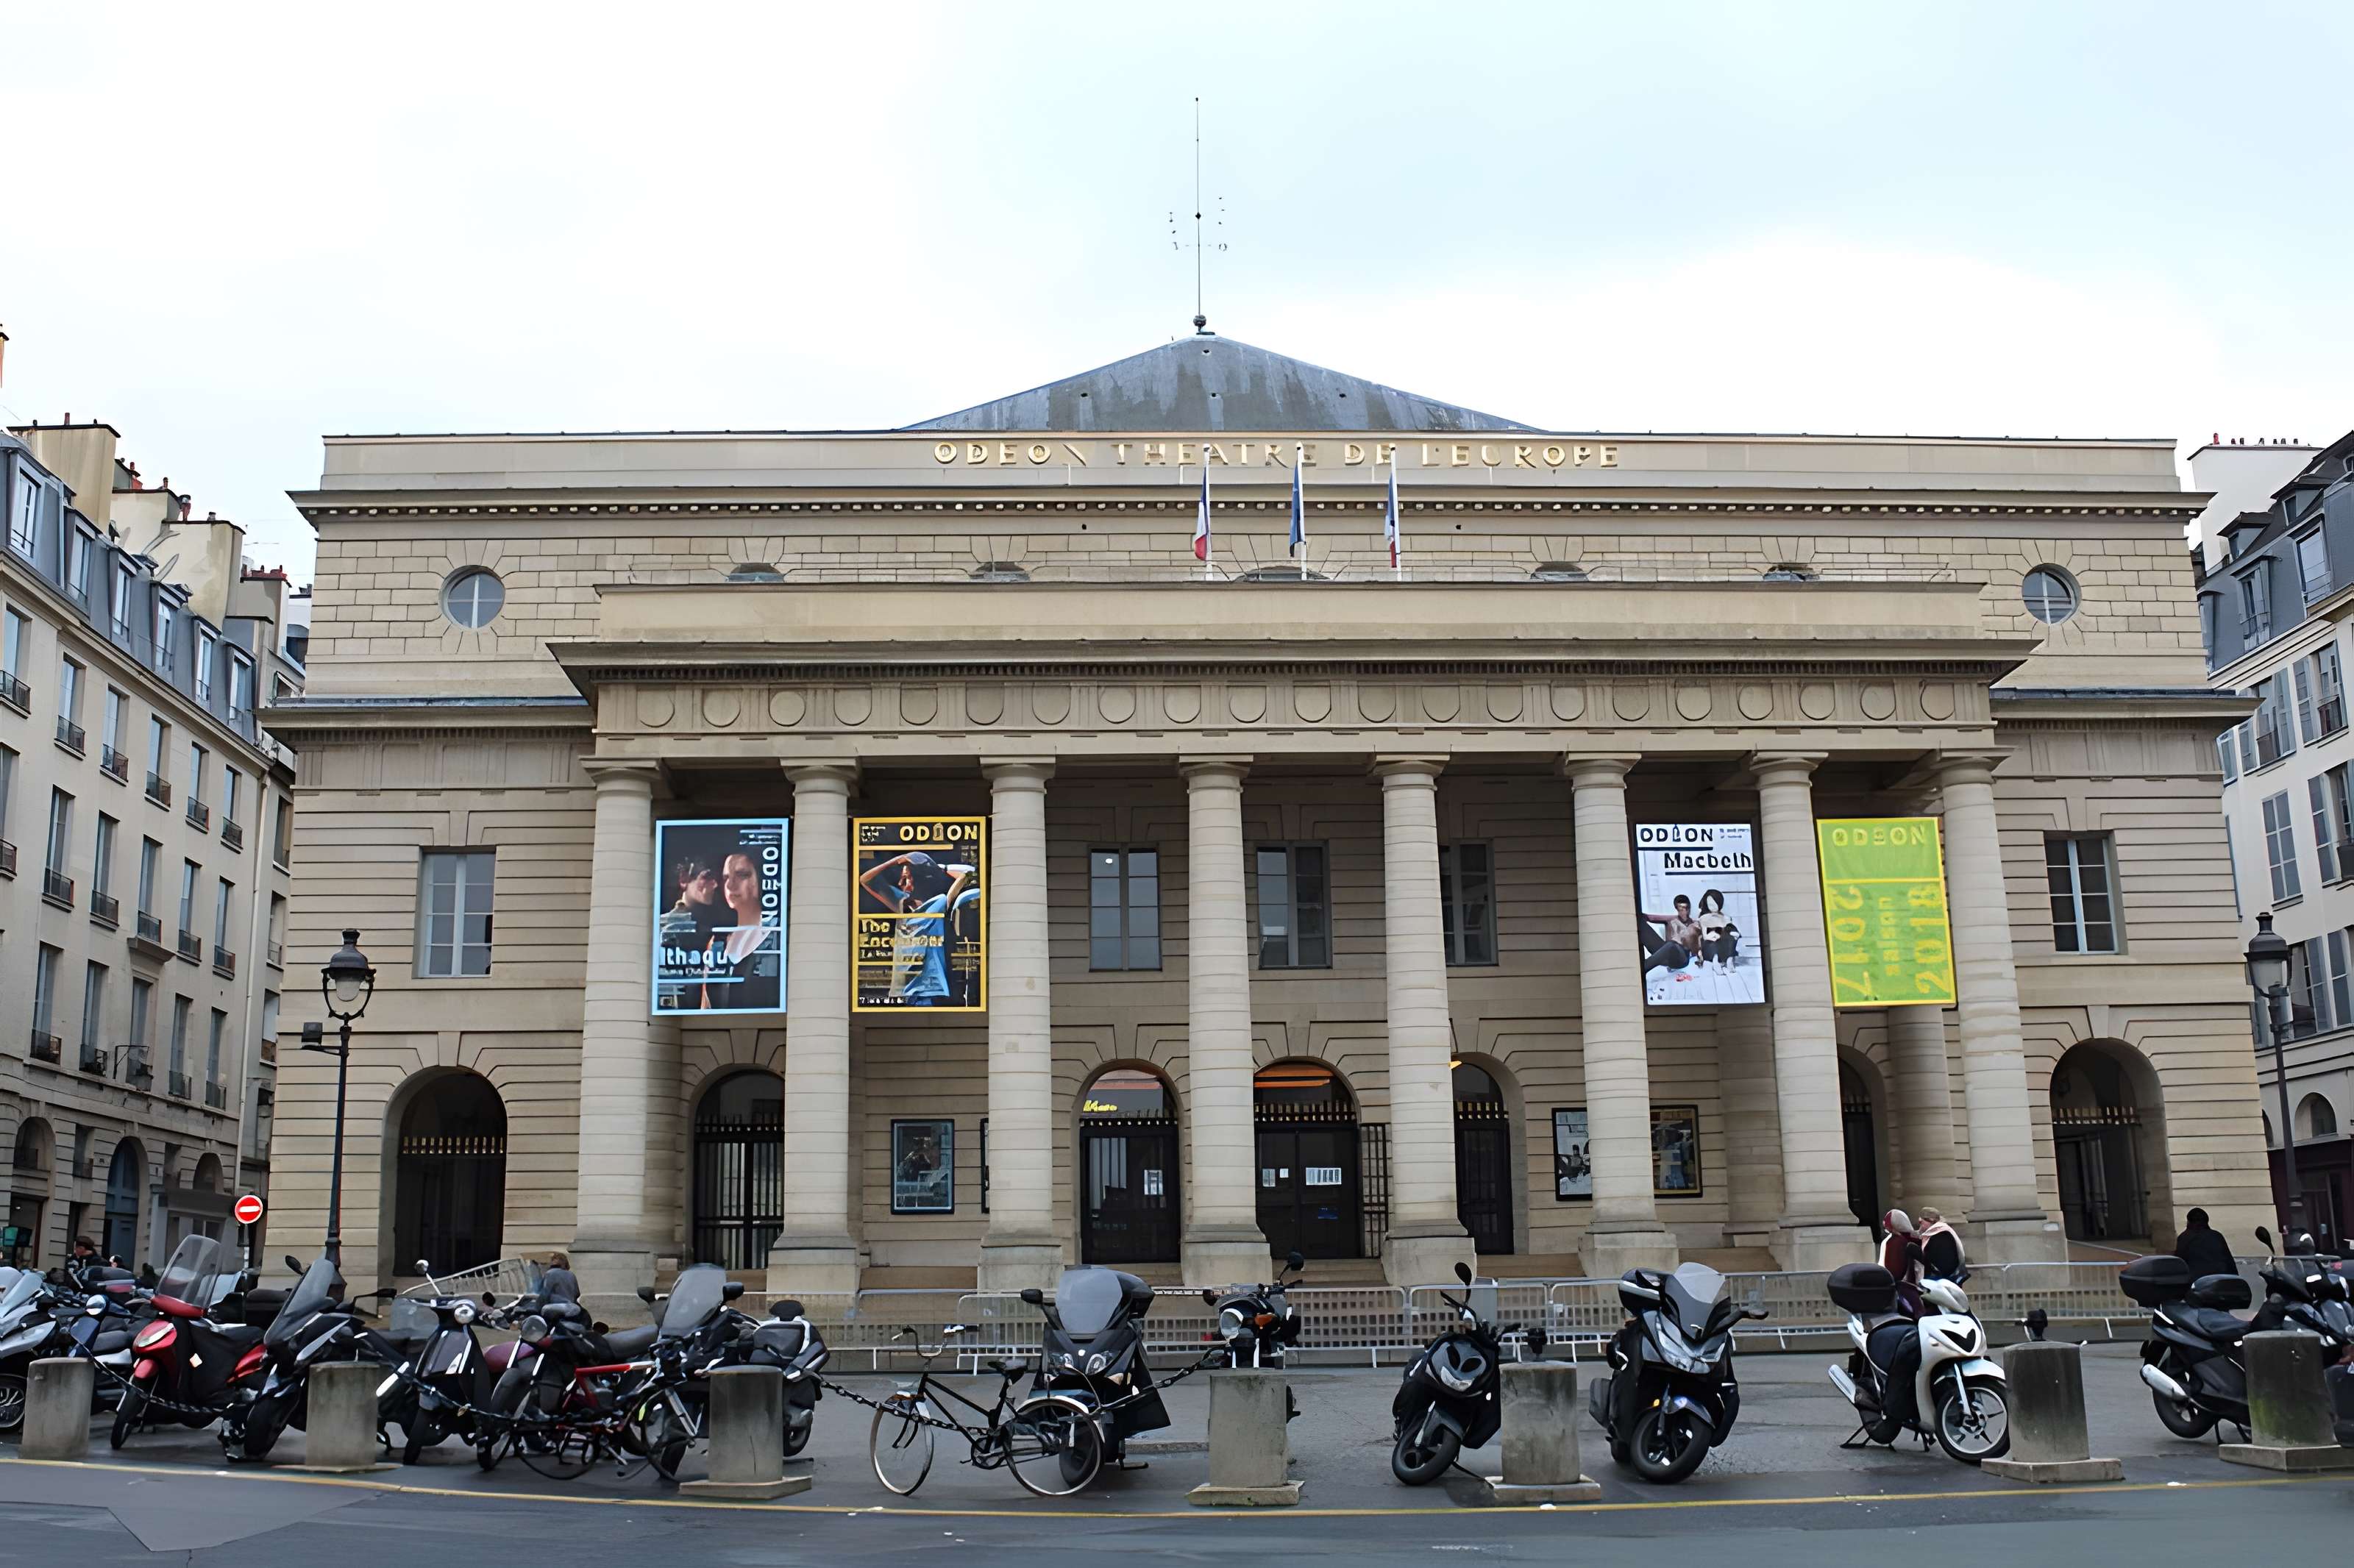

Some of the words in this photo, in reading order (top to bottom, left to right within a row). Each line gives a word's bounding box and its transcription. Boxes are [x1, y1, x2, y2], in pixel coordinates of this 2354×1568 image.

[1111, 443, 1318, 468] THEATRE
[1344, 443, 1395, 466] DE
[1664, 852, 1753, 869] Macbeth
[1829, 885, 1872, 995] 2017
[1907, 883, 1951, 994] 2018
[659, 947, 739, 969] Ithaqu
